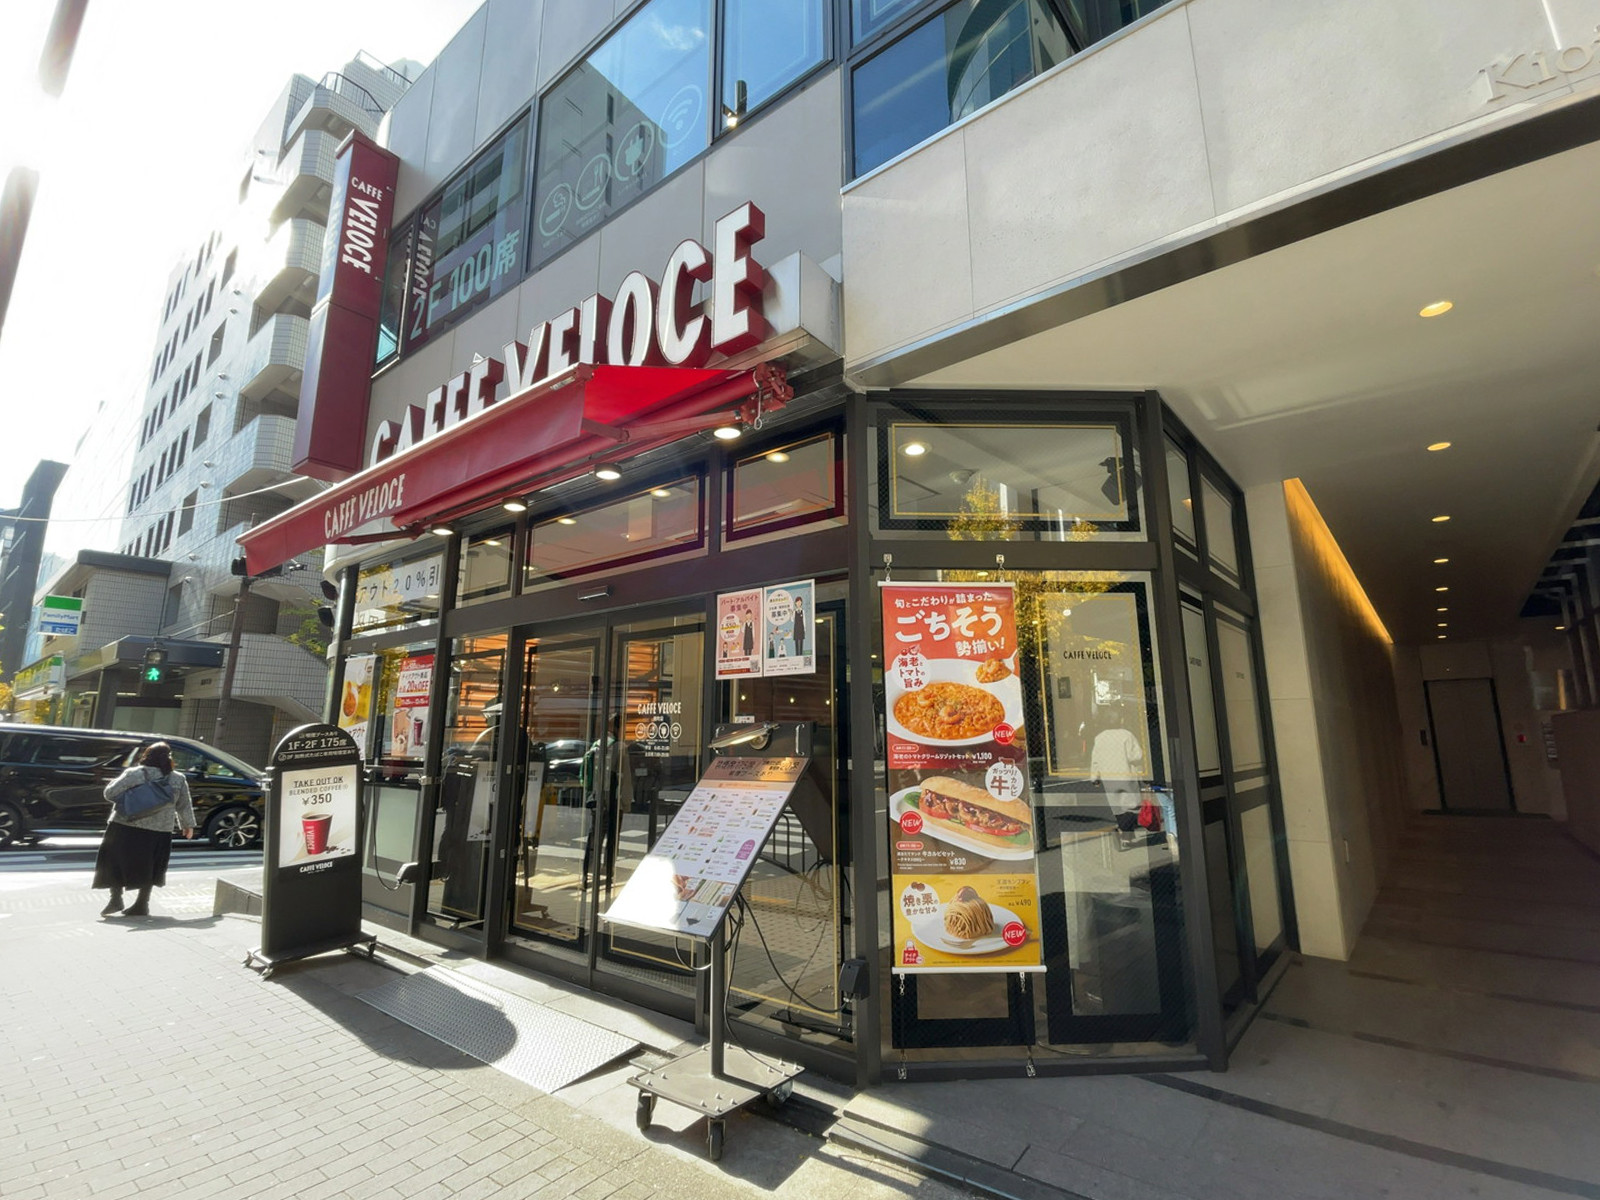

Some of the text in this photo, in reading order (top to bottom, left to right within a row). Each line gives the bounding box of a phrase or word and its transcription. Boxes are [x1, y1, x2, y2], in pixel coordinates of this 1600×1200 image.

[1478, 24, 1600, 103] Kio
[342, 197, 380, 274] VELOCE
[410, 281, 442, 341] 2F
[450, 229, 520, 310] 100席
[502, 199, 766, 397] VELOCE
[358, 473, 406, 522] VELOCE
[894, 591, 993, 608] 旬とこだわりが詰まった
[895, 605, 1003, 643] ごちそう
[903, 678, 924, 689] 旨み
[657, 702, 682, 715] VELOCE
[994, 729, 1014, 739] NEW
[293, 775, 344, 789] TAKE OUT OK
[990, 775, 1010, 796] 牛
[1010, 776, 1018, 797] カルビ
[289, 785, 342, 796] BLENDED COFFEE
[302, 792, 332, 805] ¥350
[901, 818, 921, 828] NEW
[315, 861, 333, 870] VELOCE
[903, 892, 939, 908] 焼き栗の
[906, 907, 938, 917] 豊かな甘み
[1004, 928, 1026, 939] NEW
